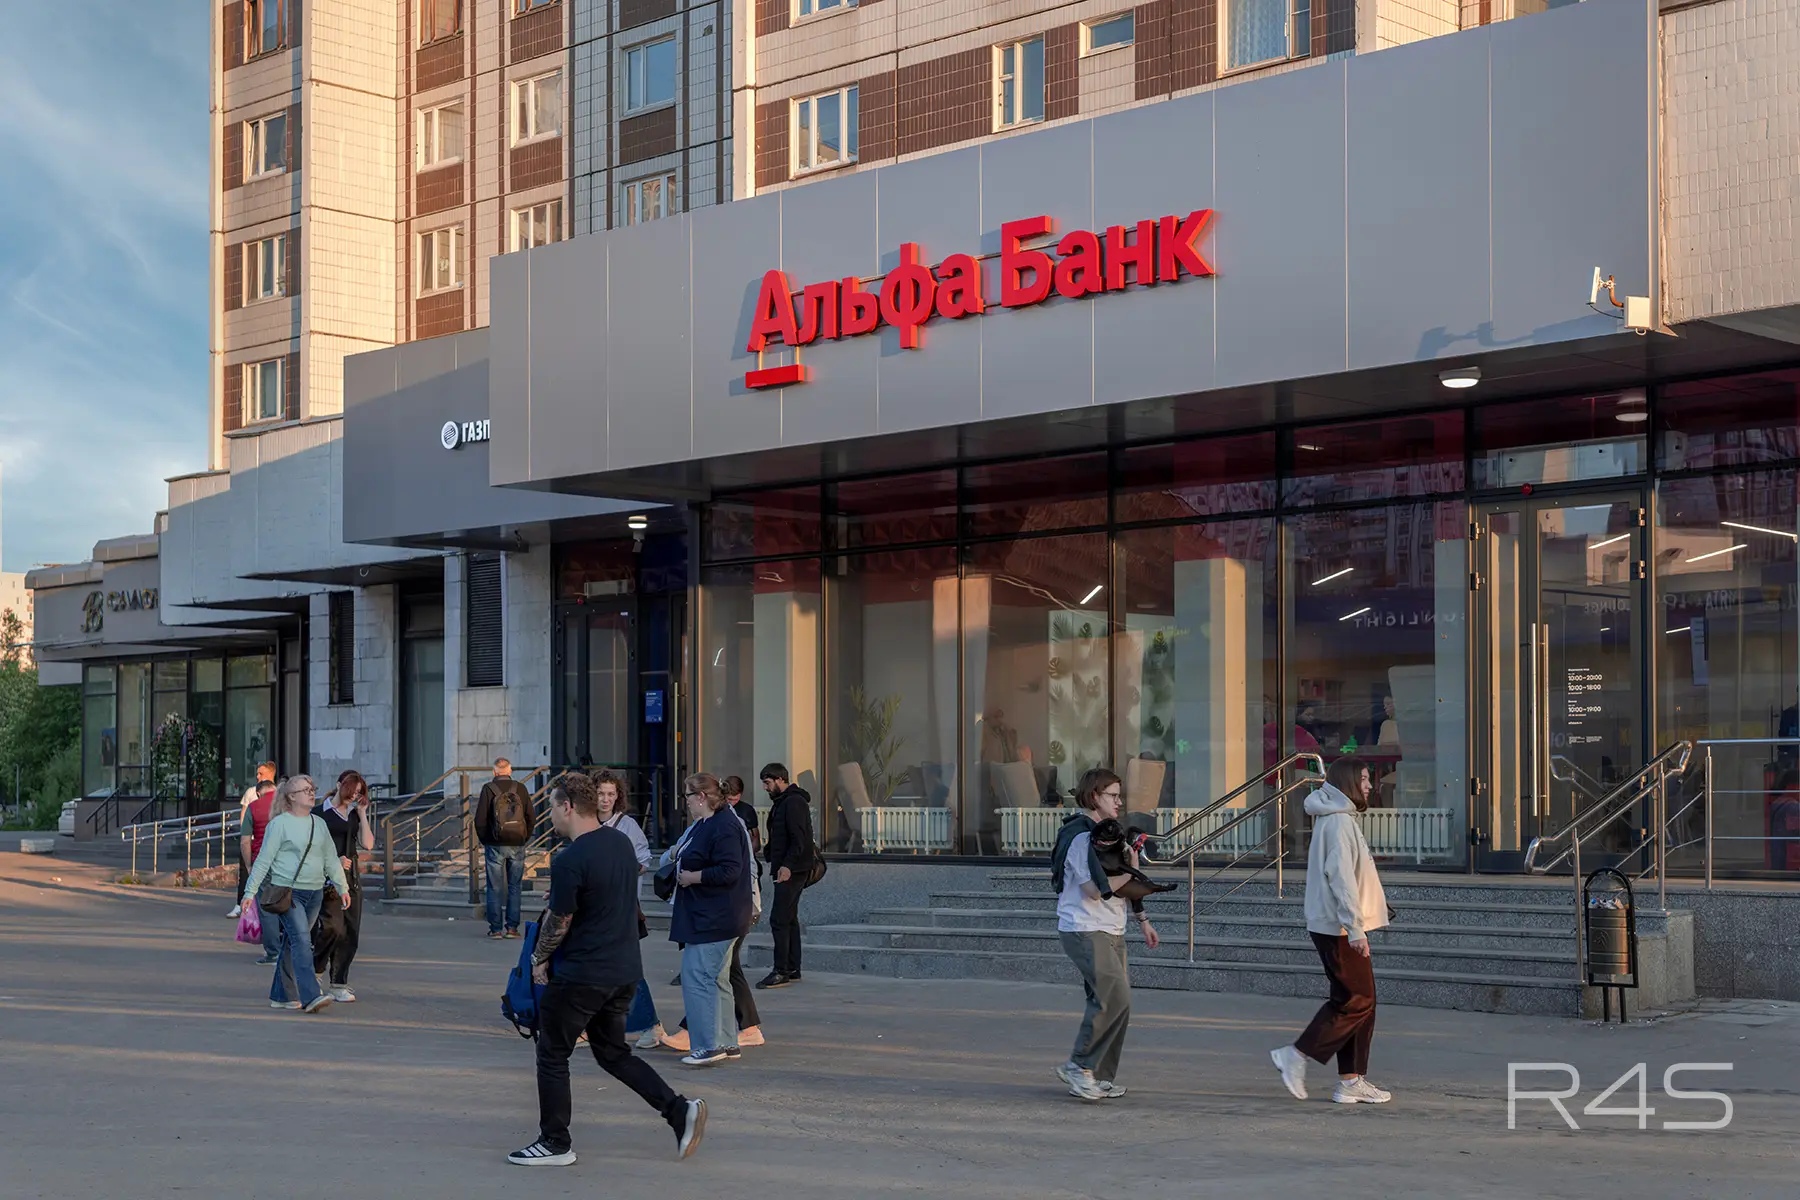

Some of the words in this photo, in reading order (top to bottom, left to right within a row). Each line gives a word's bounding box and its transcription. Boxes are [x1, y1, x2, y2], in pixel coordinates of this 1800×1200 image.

[747, 243, 985, 350] Альфа
[1001, 209, 1216, 308] Банк
[462, 419, 490, 442] ГАЗП
